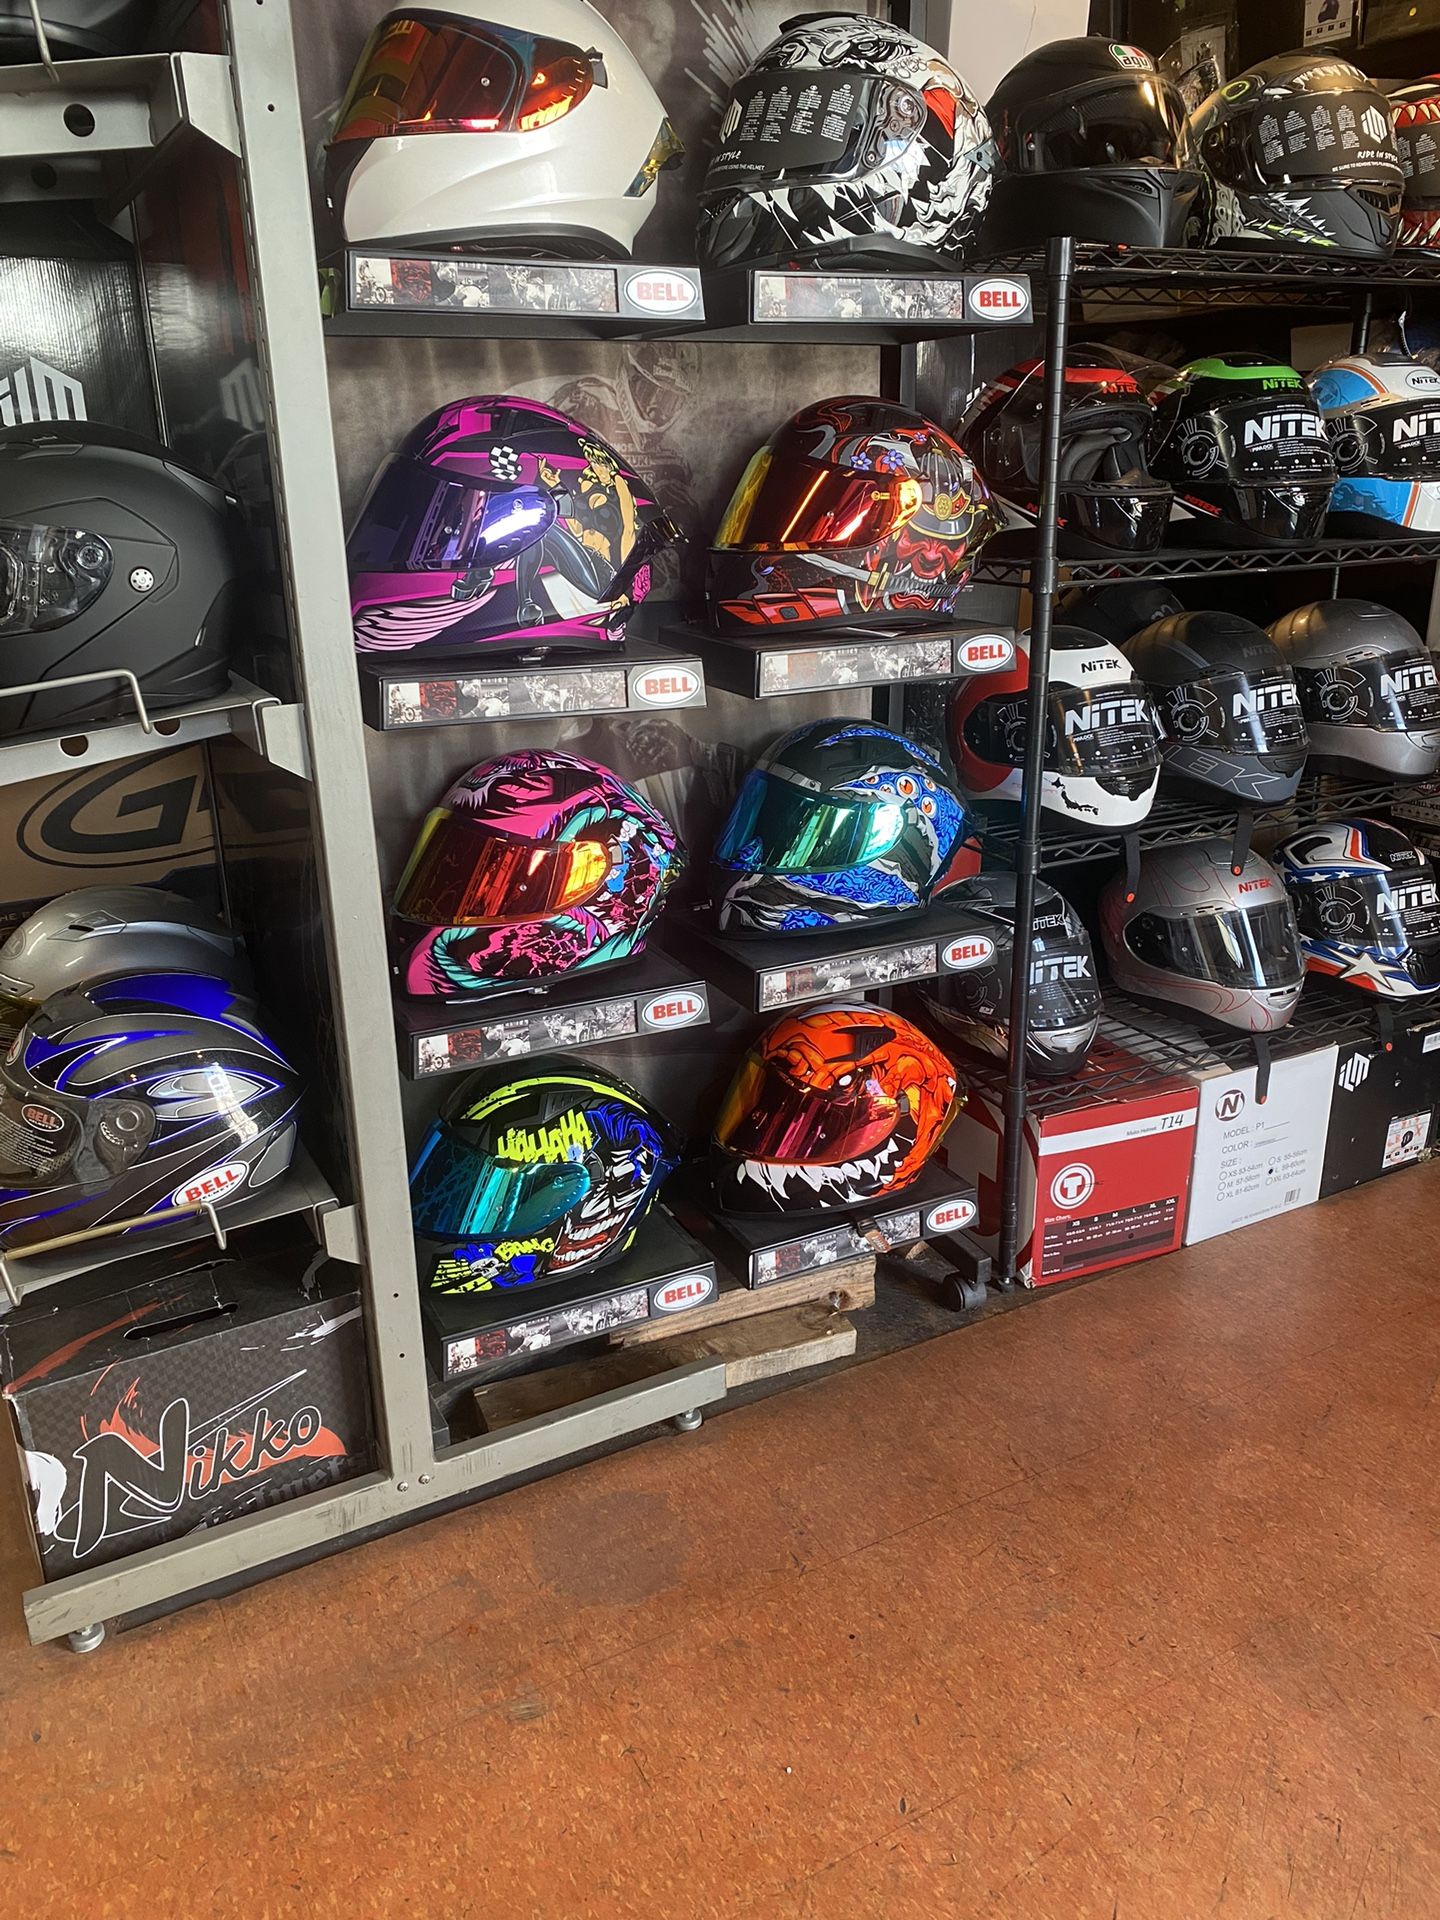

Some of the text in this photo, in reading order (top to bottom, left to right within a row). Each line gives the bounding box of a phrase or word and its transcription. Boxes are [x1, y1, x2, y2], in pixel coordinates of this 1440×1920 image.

[1357, 150, 1375, 159] RIDE
[636, 281, 690, 302] BELL
[979, 291, 1022, 309] BELL
[967, 643, 1007, 662] BELL
[643, 676, 693, 696] BELL
[951, 942, 988, 961] BELL
[652, 995, 698, 1020] BELL
[26, 1107, 57, 1127] BELL
[1161, 1114, 1184, 1130] T14
[1222, 1126, 1250, 1140] MODEL
[1221, 1140, 1250, 1155] COLOR
[1220, 1157, 1238, 1169] SIZE
[184, 1169, 240, 1202] BELL
[935, 1206, 970, 1226] BELL
[494, 1237, 556, 1262] BANG
[663, 1281, 706, 1304] BELL
[53, 1397, 323, 1559] Nikko
